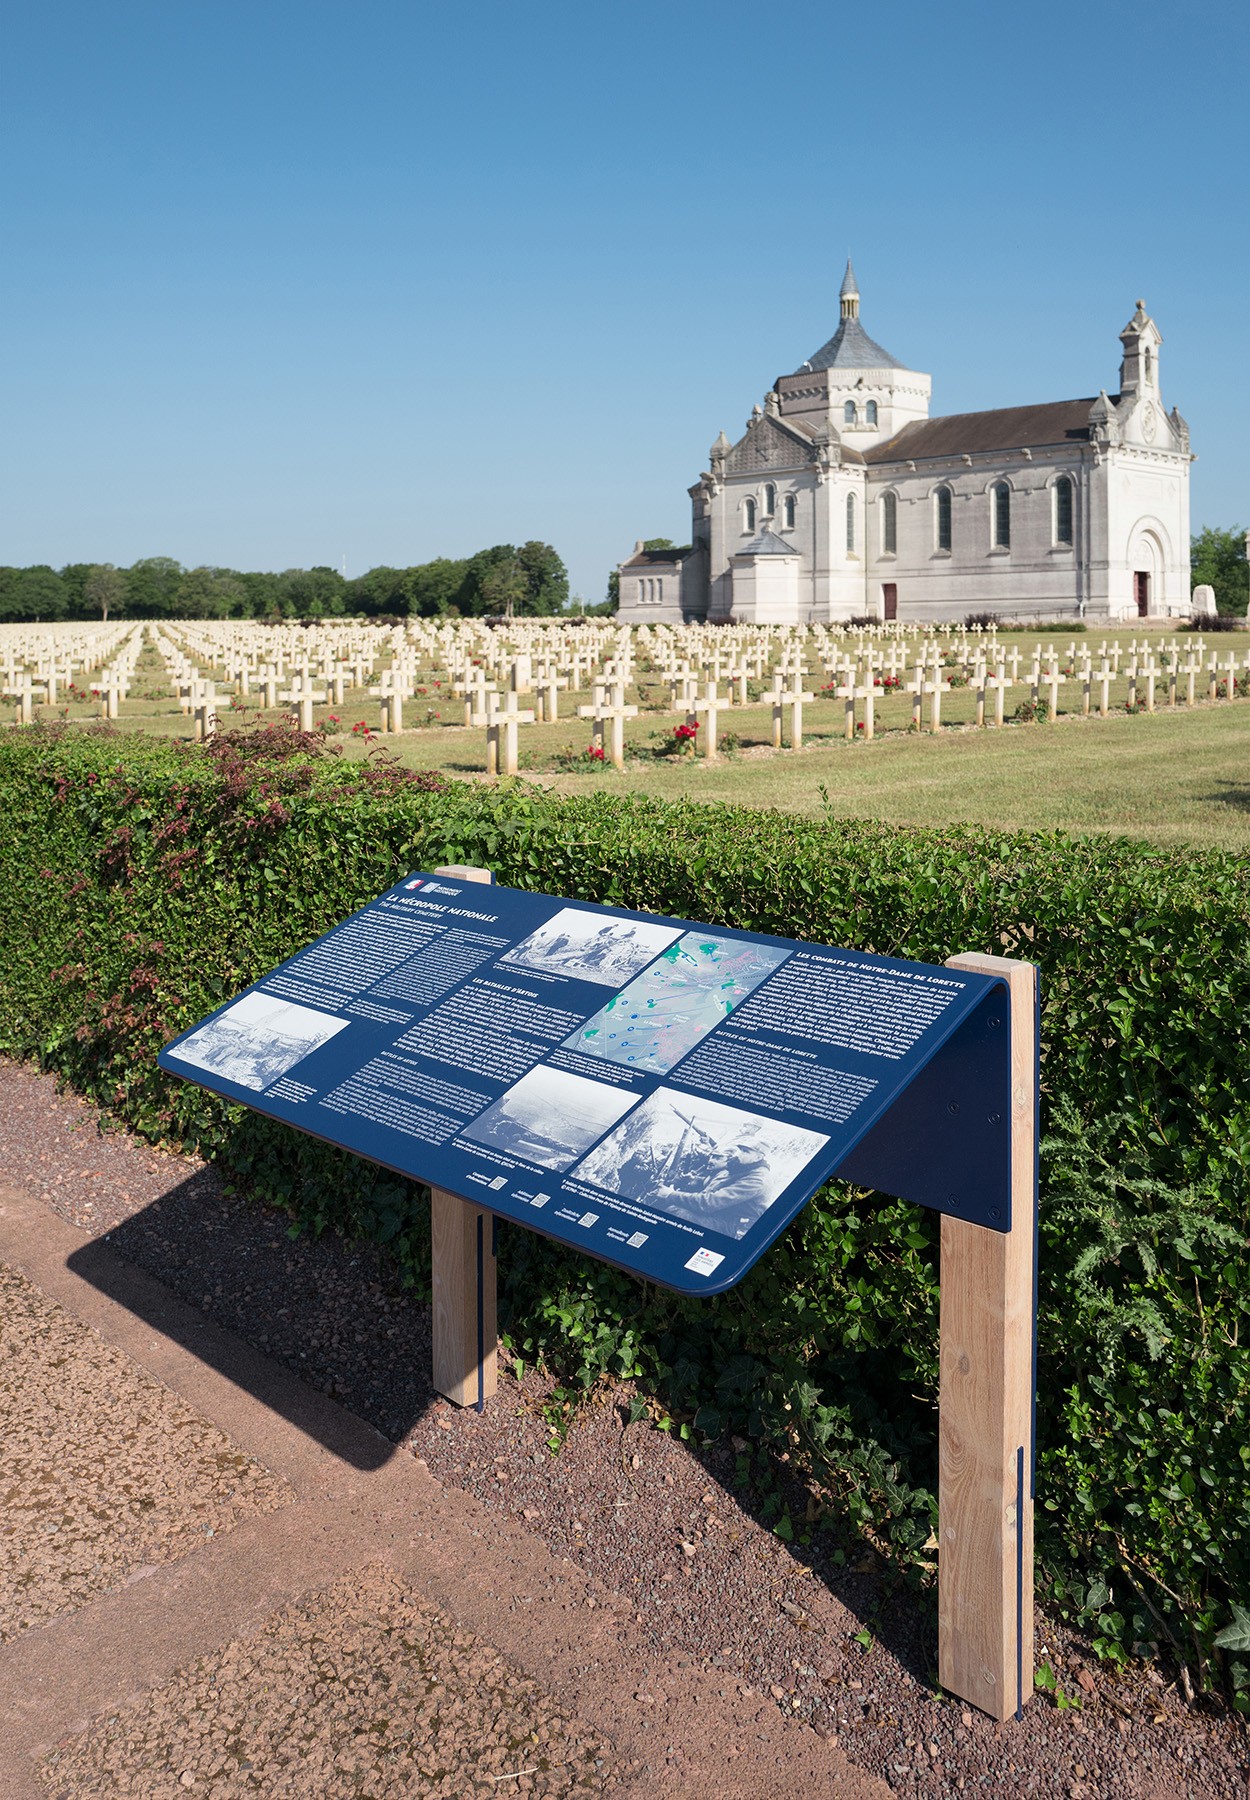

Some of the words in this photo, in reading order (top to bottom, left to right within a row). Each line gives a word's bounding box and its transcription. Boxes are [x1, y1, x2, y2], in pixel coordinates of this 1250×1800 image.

[397, 895, 452, 912] NÉCROPOLE
[445, 907, 500, 922] NATIONALE
[809, 955, 847, 965] COMBATS
[857, 963, 915, 978] NOTRE-DAME
[925, 976, 967, 988] LORETTE
